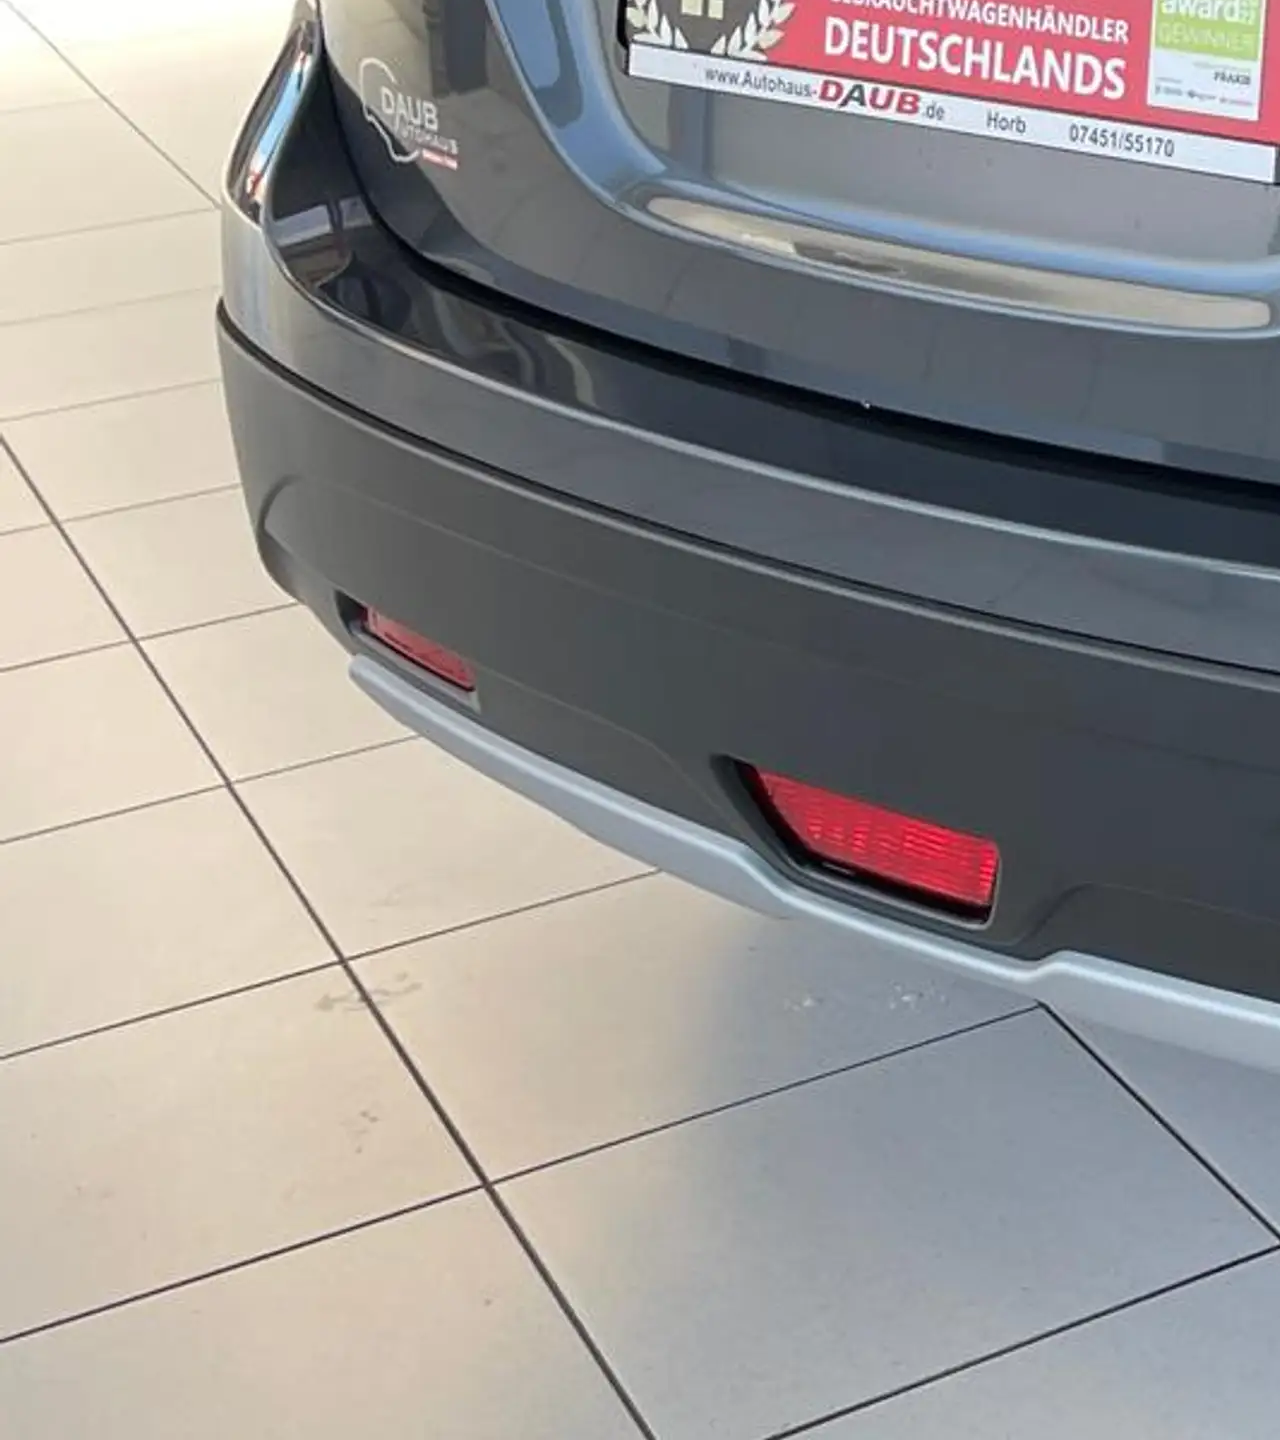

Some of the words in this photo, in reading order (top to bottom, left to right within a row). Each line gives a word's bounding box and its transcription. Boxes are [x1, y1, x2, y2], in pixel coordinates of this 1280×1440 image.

[824, 16, 1127, 100] DEUTSCHLANDS
[381, 86, 438, 132] DAUB
[986, 110, 1027, 134] Horb
[1068, 122, 1175, 158] 07451/55170
